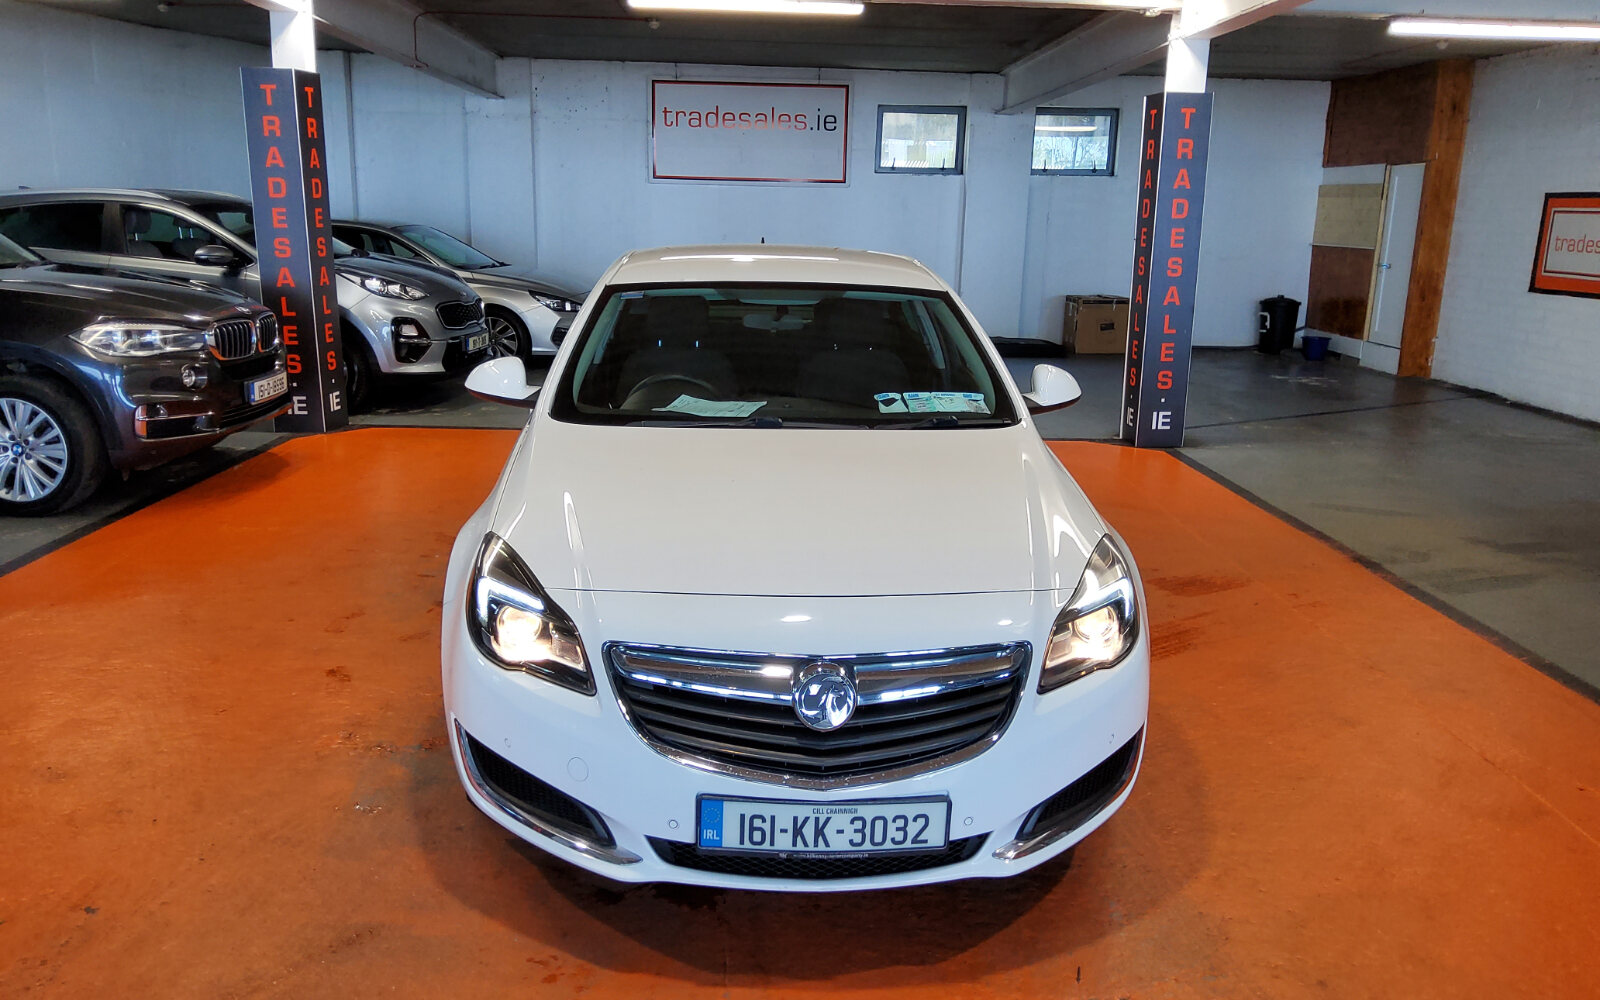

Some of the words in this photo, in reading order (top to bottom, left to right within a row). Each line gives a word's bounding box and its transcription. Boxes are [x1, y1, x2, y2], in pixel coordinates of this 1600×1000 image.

[662, 105, 838, 132] tradesales.ie
[259, 83, 309, 415] TRADESALES.E
[703, 829, 720, 841] IRL
[739, 813, 930, 848] 161-KK-3032
